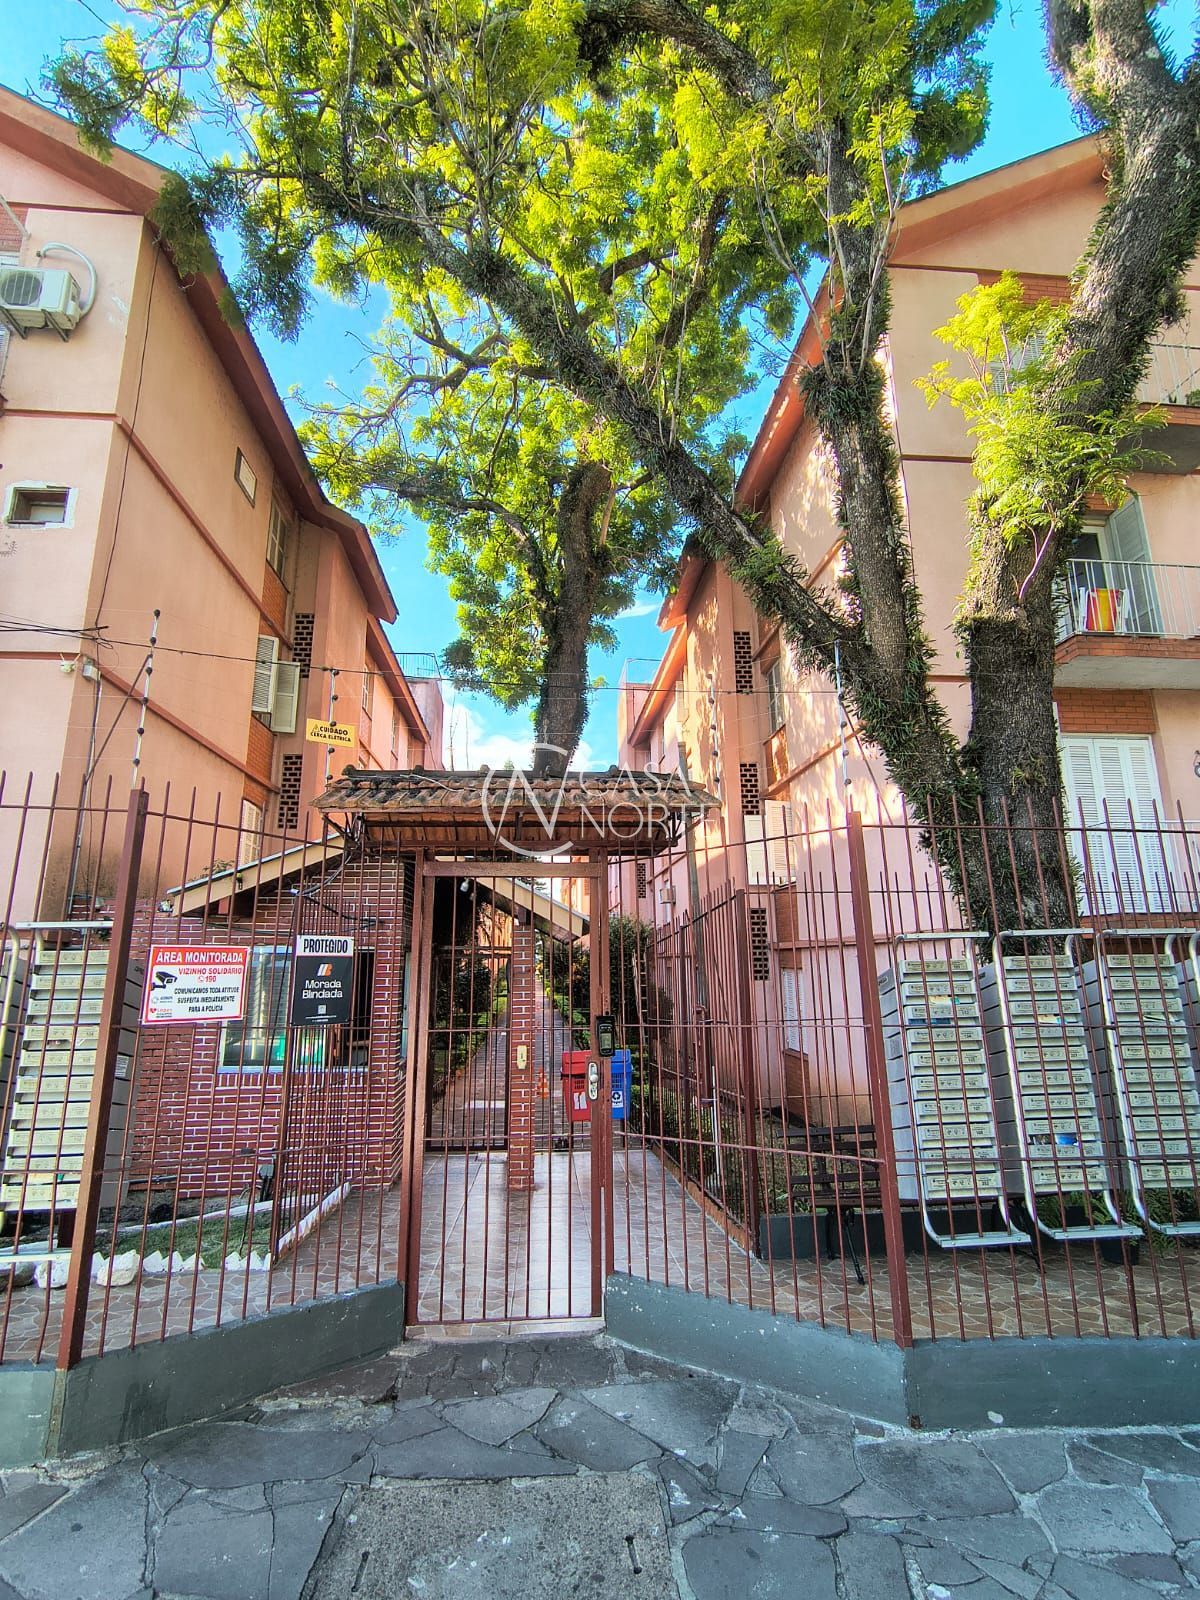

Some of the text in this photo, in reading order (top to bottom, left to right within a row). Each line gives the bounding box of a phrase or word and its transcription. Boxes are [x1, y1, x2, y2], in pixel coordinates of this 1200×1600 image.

[319, 726, 349, 736] CUIDADO
[303, 938, 349, 953] PROTEGIDO
[156, 948, 243, 963] ÁREA MONITORADA
[178, 967, 207, 975] VIZINHO
[204, 975, 217, 983] 190
[304, 979, 342, 989] Morada
[174, 987, 209, 995] COMUNICAMOS
[302, 989, 343, 999] Blindada
